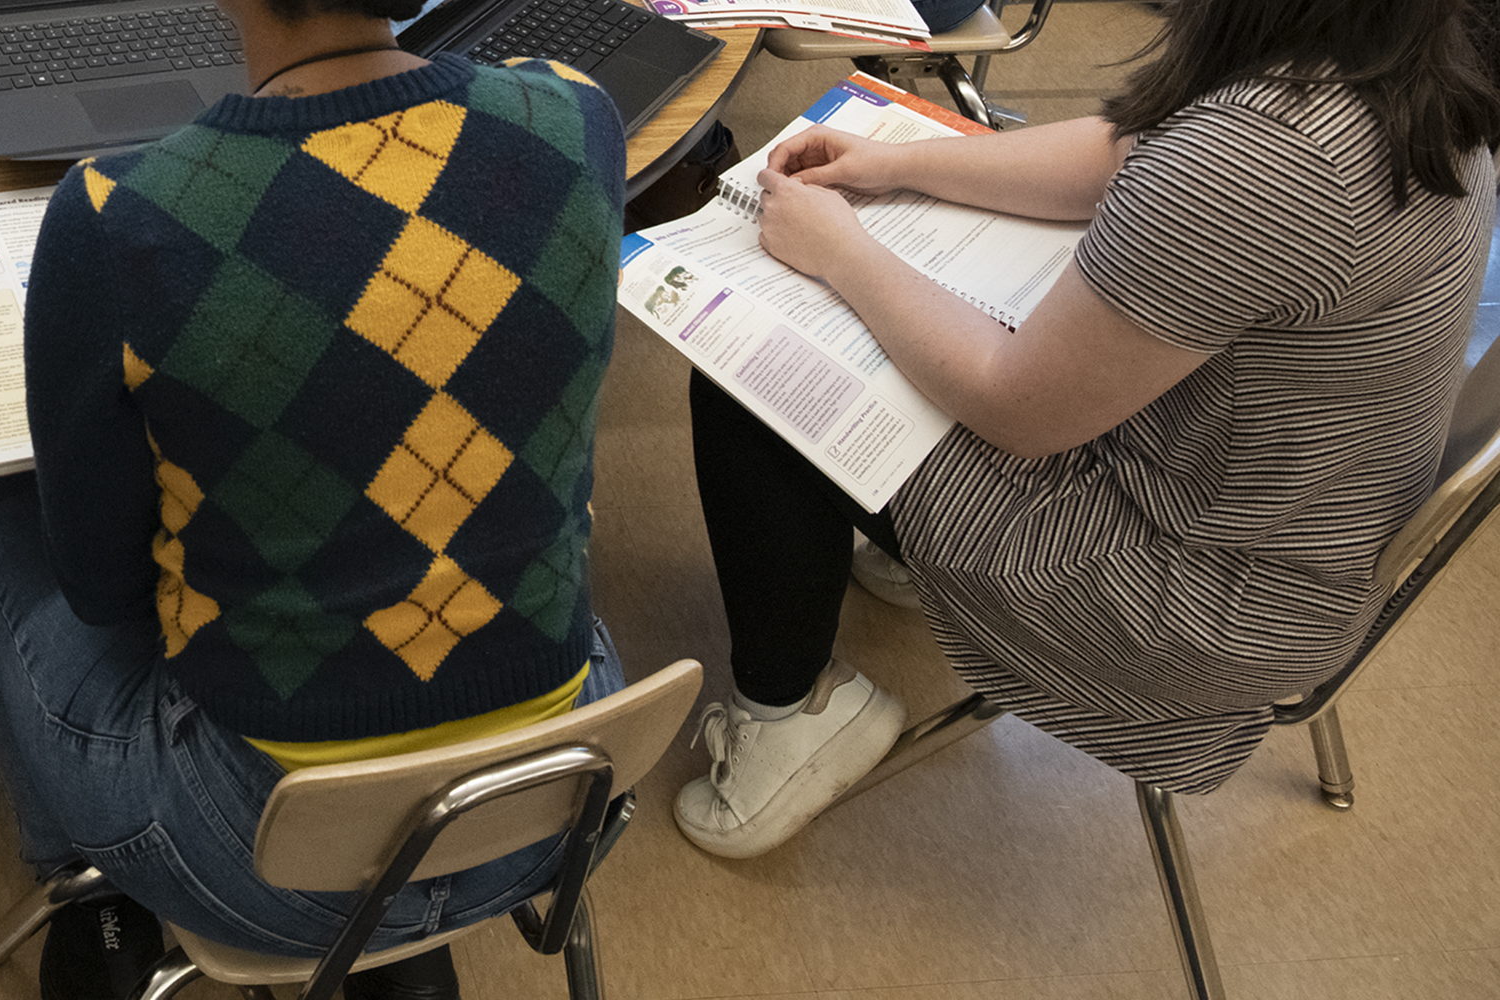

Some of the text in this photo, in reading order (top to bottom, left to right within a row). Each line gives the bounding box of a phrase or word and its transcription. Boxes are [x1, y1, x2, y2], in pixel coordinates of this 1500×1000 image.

[17, 195, 50, 203] Reading
[734, 354, 758, 378] Conferring
[836, 416, 864, 447] Handwriting
[859, 398, 878, 419] Practice
